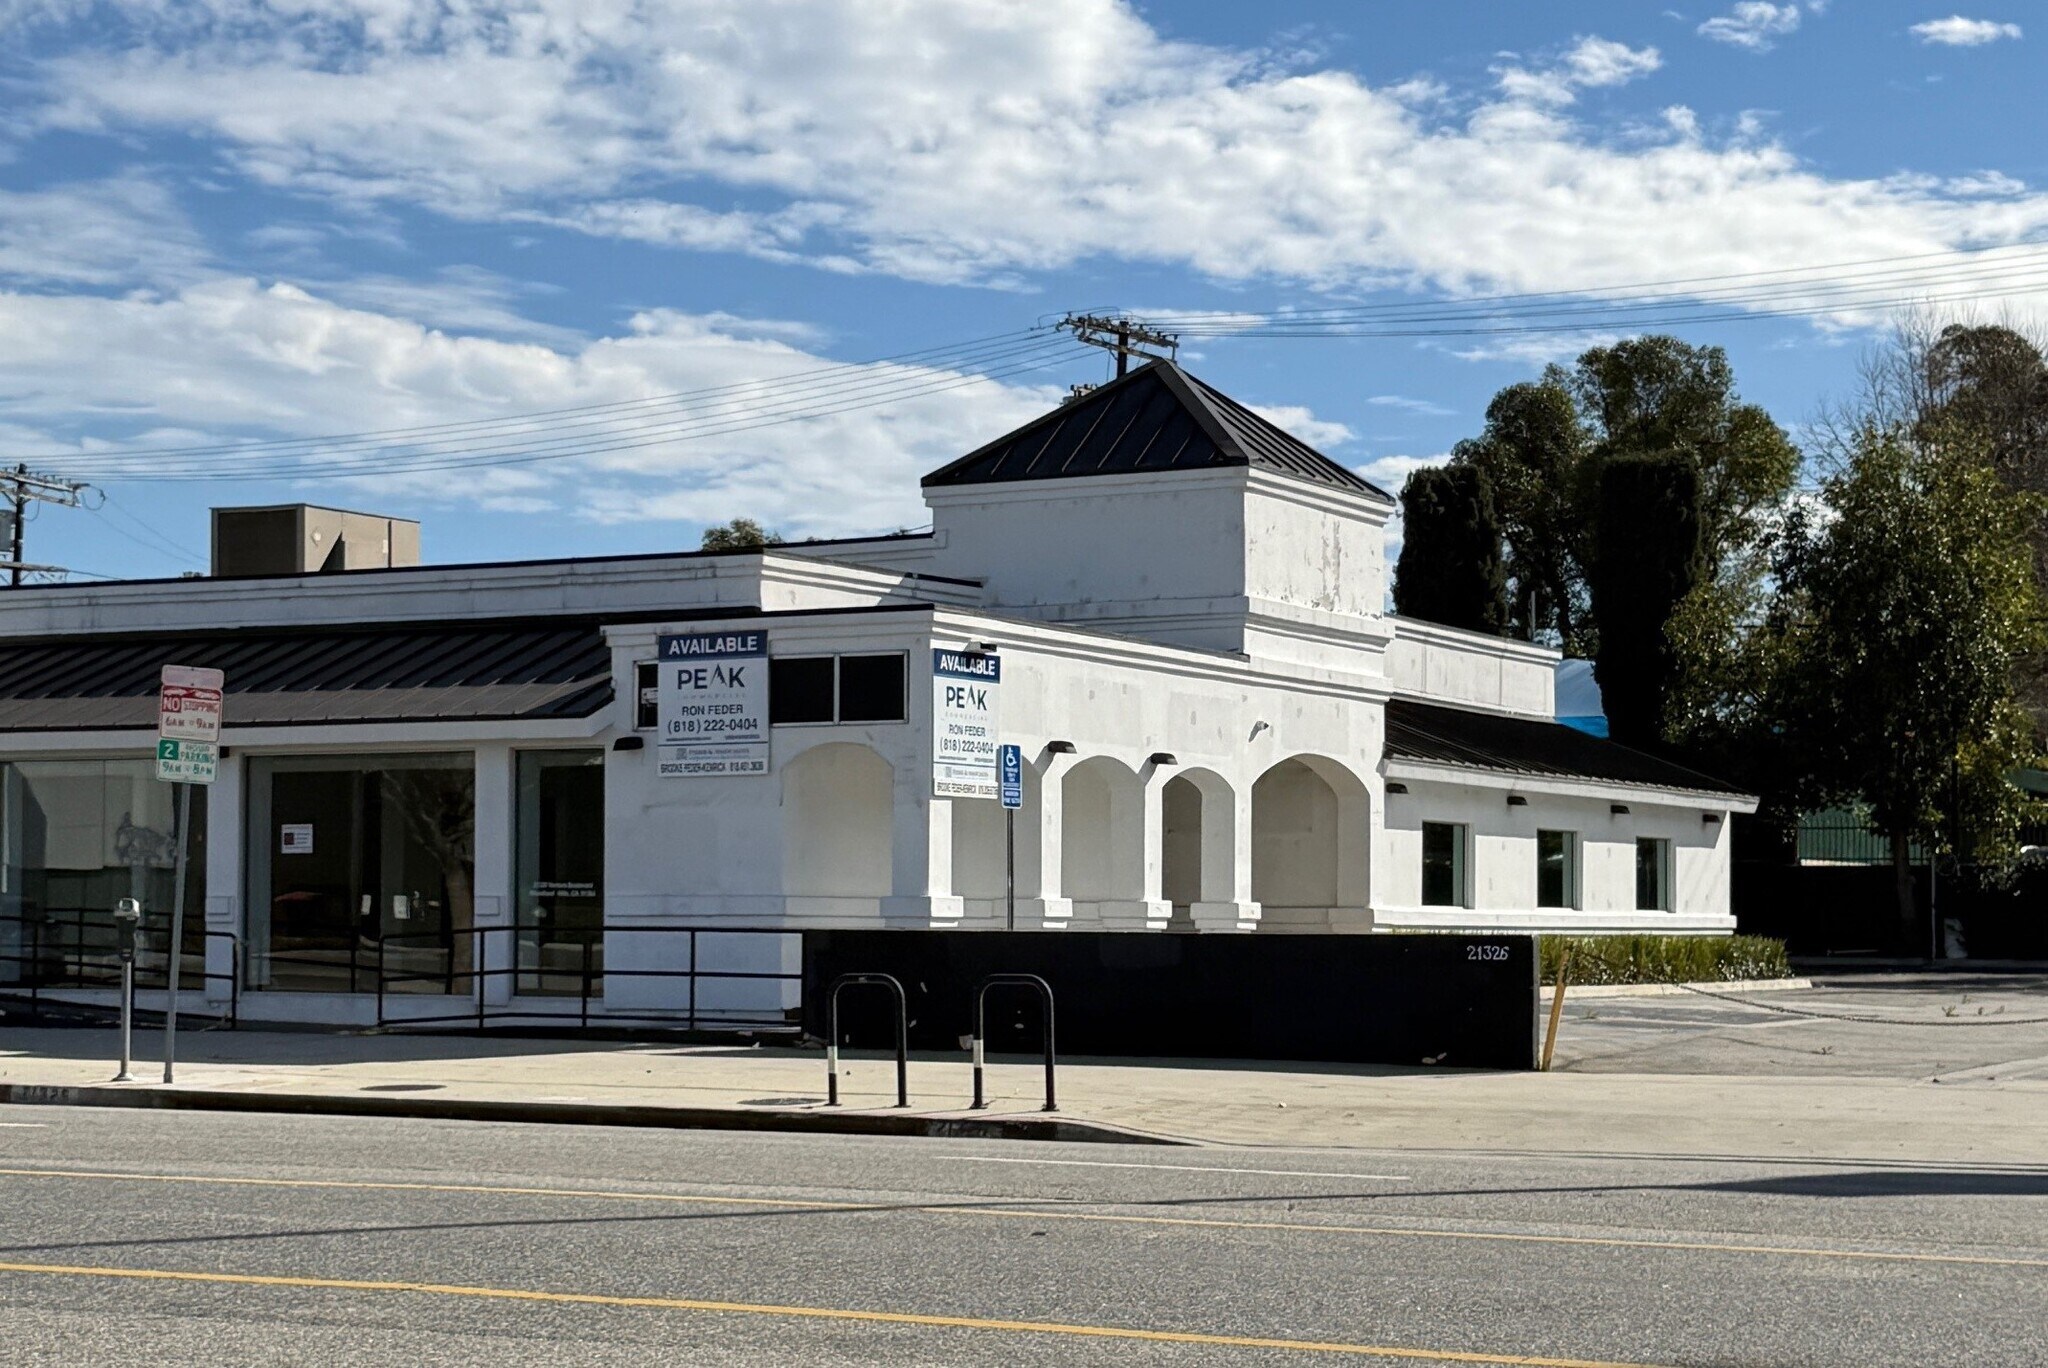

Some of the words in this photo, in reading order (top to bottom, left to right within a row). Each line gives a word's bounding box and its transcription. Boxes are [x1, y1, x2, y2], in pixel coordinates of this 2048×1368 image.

[668, 636, 758, 655] AVAILABLE
[940, 655, 996, 676] AVAILABLE
[677, 664, 745, 690] PEAK
[163, 697, 181, 712] NO
[946, 685, 988, 711] PEAK
[681, 705, 705, 717] RON
[708, 704, 743, 715] FEDER
[667, 719, 701, 734] (818)
[703, 718, 758, 732] 222-0404
[949, 723, 964, 735] RON
[964, 725, 986, 737] FEDER
[164, 743, 174, 758] 2
[940, 737, 962, 753] (818)
[962, 740, 994, 755] 222-0404
[180, 751, 215, 765] PARKING
[1466, 945, 1510, 960] 21326
